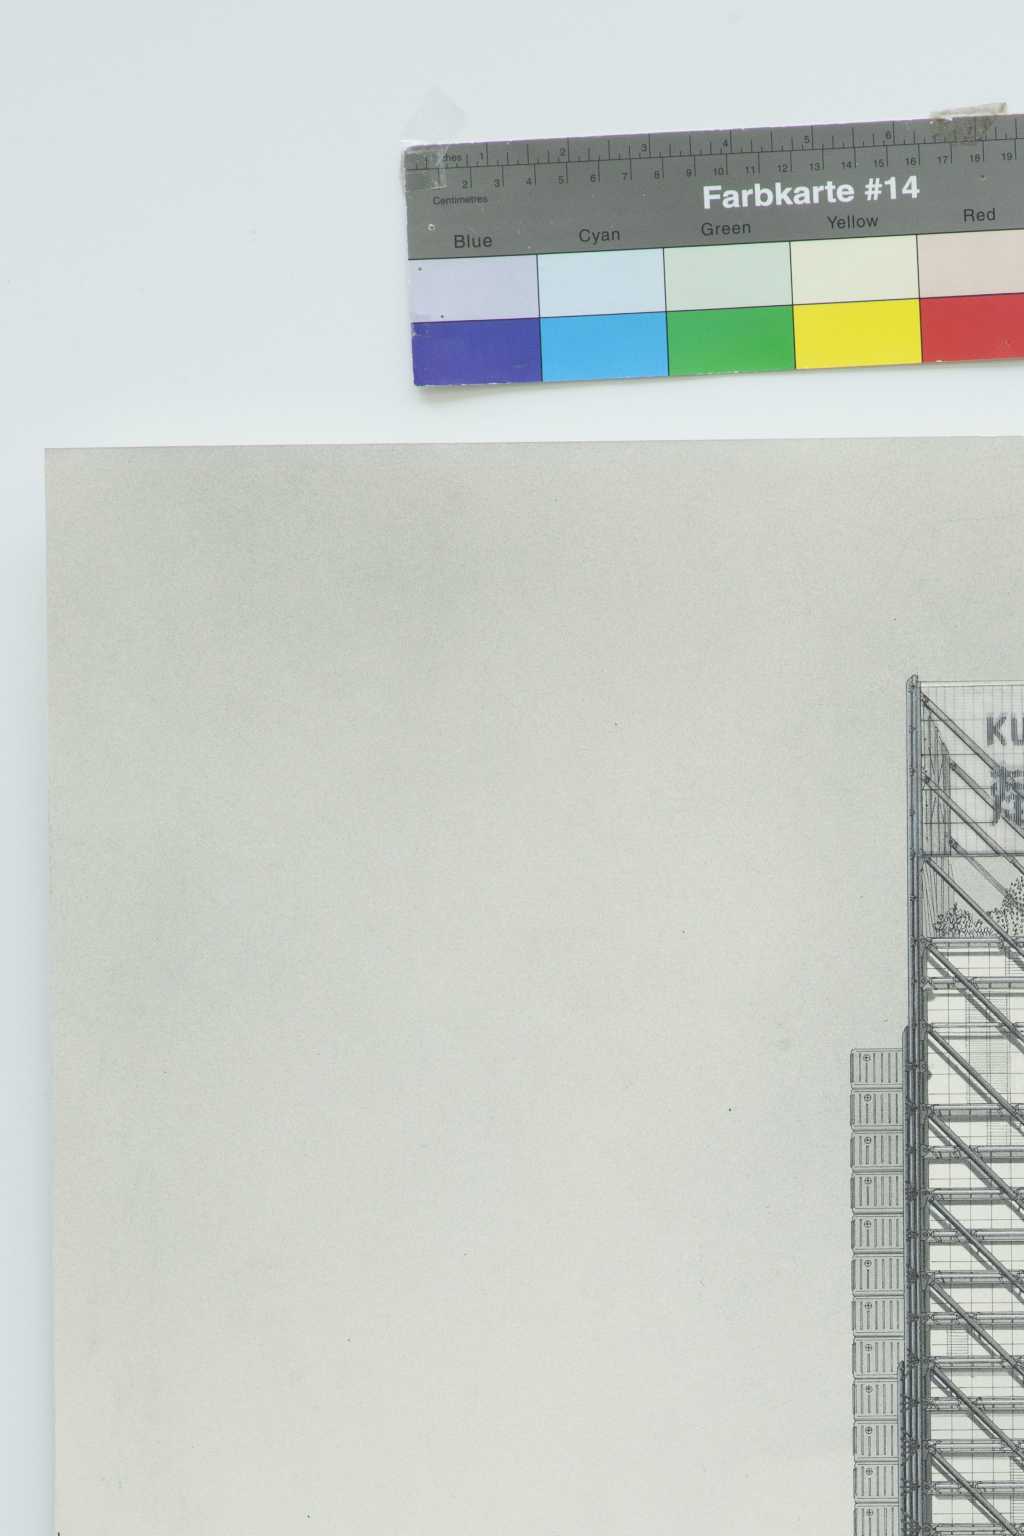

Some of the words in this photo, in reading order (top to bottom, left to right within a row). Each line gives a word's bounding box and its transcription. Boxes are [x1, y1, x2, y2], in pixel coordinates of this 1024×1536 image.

[462, 180, 468, 188] 2
[494, 179, 500, 187] 3
[526, 177, 532, 185] 4
[558, 176, 564, 184] 5
[590, 174, 596, 182] 6
[622, 172, 628, 180] 7
[654, 170, 660, 179] 8
[686, 169, 692, 177] 9
[713, 168, 724, 176] 10
[746, 166, 755, 174] 11
[778, 164, 788, 173] 12
[810, 163, 820, 171] 13
[842, 161, 852, 169] 14
[874, 160, 884, 168] 15
[905, 157, 917, 165] 16
[938, 156, 948, 164] 17
[970, 154, 980, 162] 18
[1002, 152, 1012, 161] 19
[703, 181, 855, 210] Farbkarte
[865, 175, 920, 201] #14
[453, 233, 494, 249] Blue
[578, 228, 621, 246] Cyan
[701, 222, 751, 236] Green
[826, 215, 879, 230] Yellow
[963, 207, 996, 223] Red
